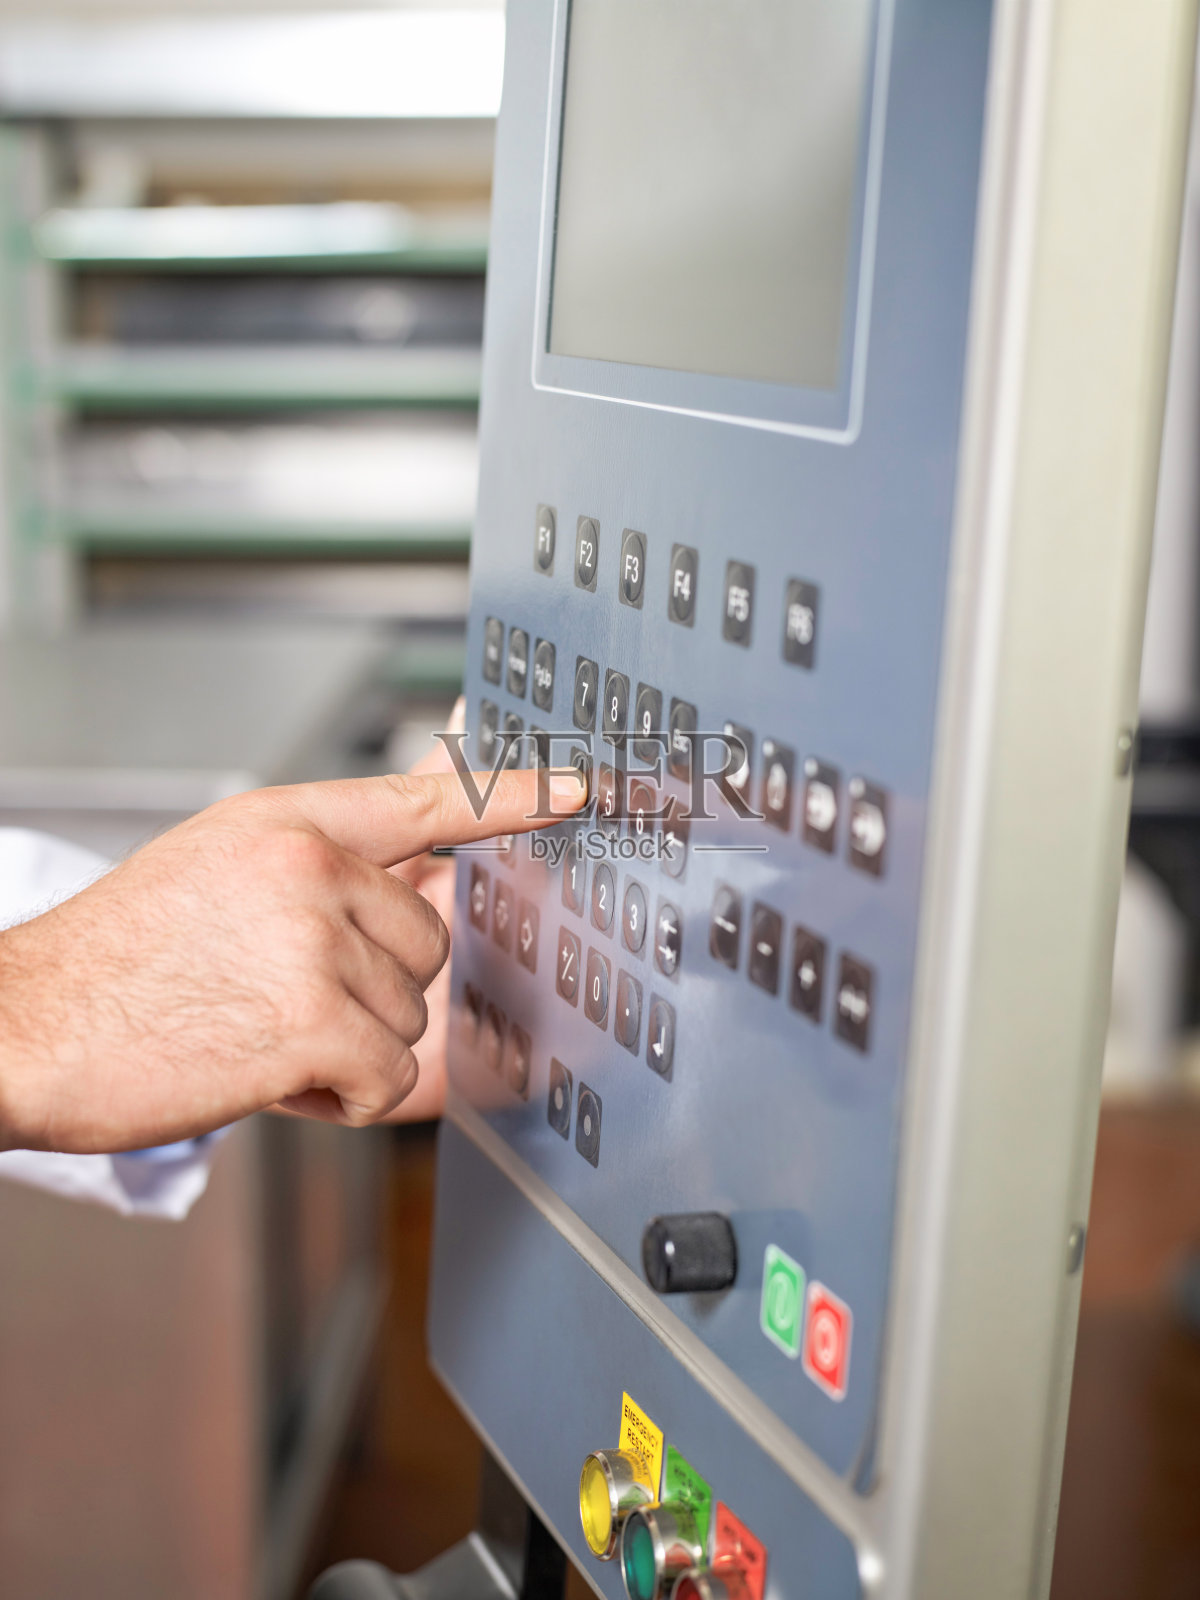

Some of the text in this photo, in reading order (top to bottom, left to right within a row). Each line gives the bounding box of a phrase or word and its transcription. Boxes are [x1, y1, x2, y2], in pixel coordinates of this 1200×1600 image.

[538, 526, 551, 554] F1
[580, 540, 593, 568] F2
[625, 554, 639, 583] F3
[673, 569, 690, 602] F4
[727, 585, 750, 622] F5
[581, 681, 589, 708] 7
[611, 696, 619, 722] 8
[642, 710, 651, 738] 9
[604, 790, 613, 816] 5
[635, 808, 644, 835] 6
[571, 865, 577, 890] 1
[599, 884, 607, 911] 2
[629, 904, 638, 931] 3
[593, 976, 600, 1001] 0
[624, 1404, 659, 1449] EMERGENCY
[626, 1428, 655, 1466] RESTART
